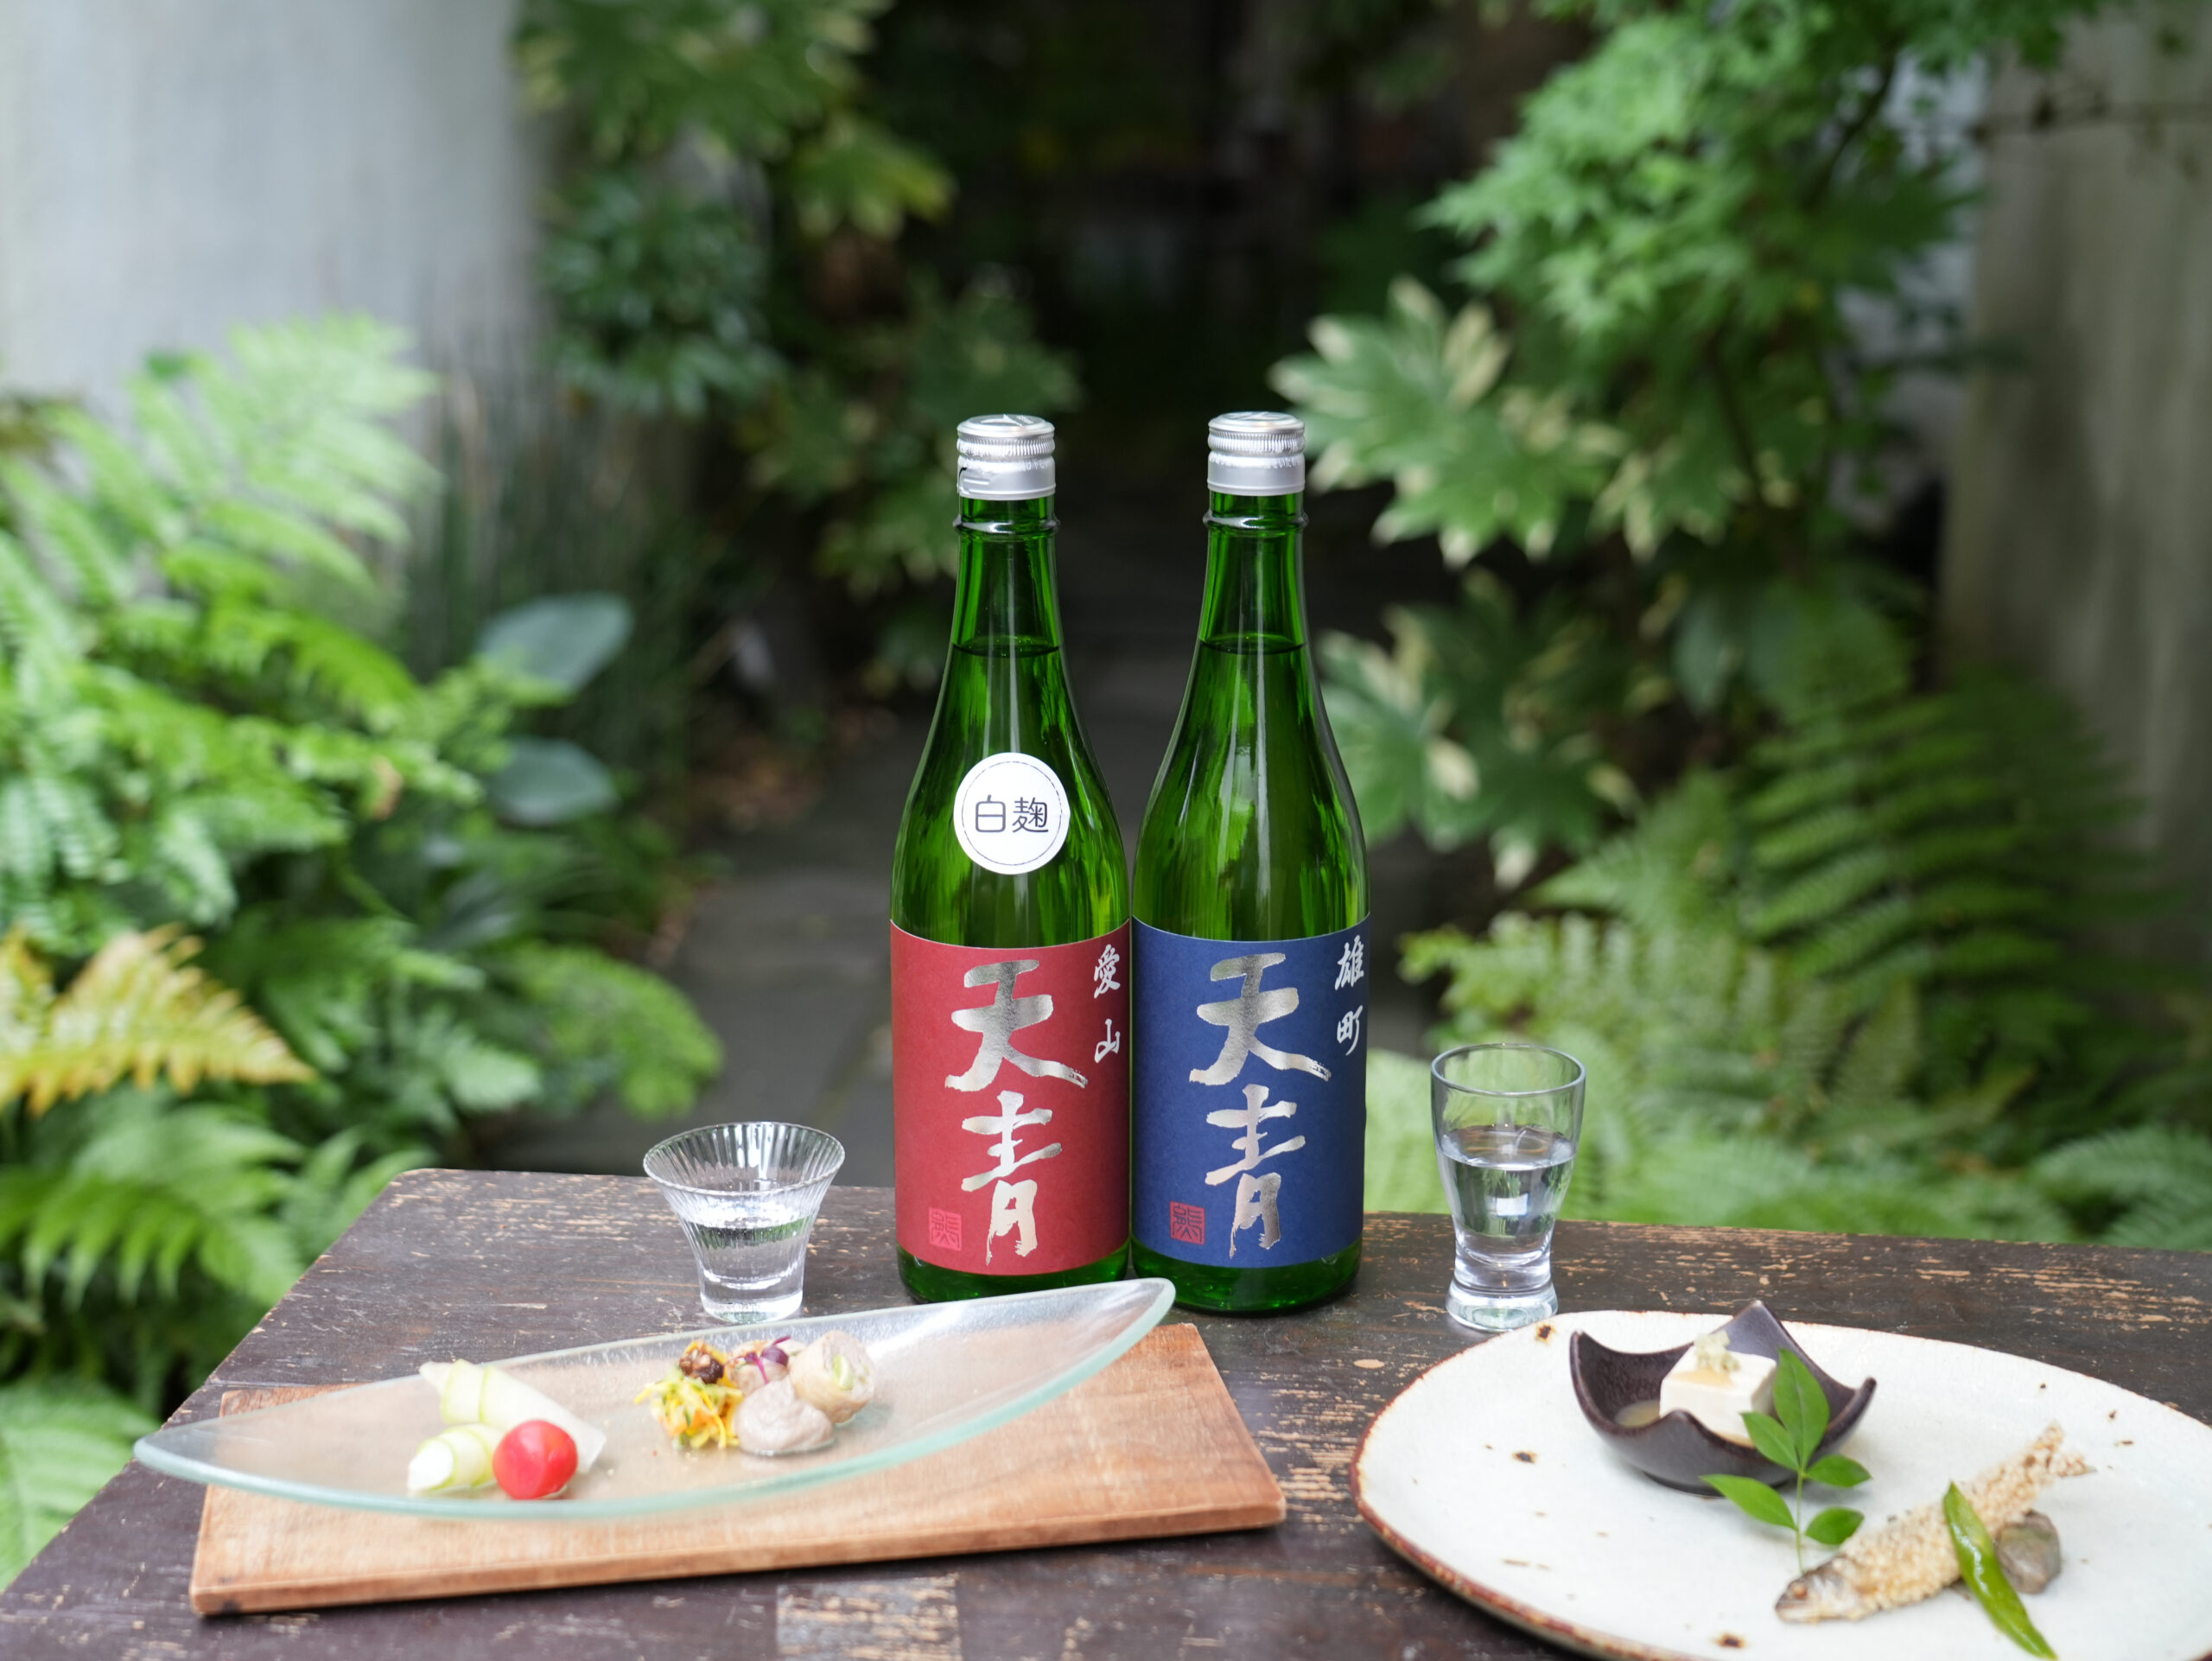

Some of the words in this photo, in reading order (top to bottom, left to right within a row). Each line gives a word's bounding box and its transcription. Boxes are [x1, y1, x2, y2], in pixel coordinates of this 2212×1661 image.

[975, 794, 1049, 833] 白麹
[1093, 943, 1122, 1064] 愛山
[1334, 934, 1365, 1057] 雄町
[944, 959, 1089, 1266] 天青
[1189, 952, 1332, 1259] 天青
